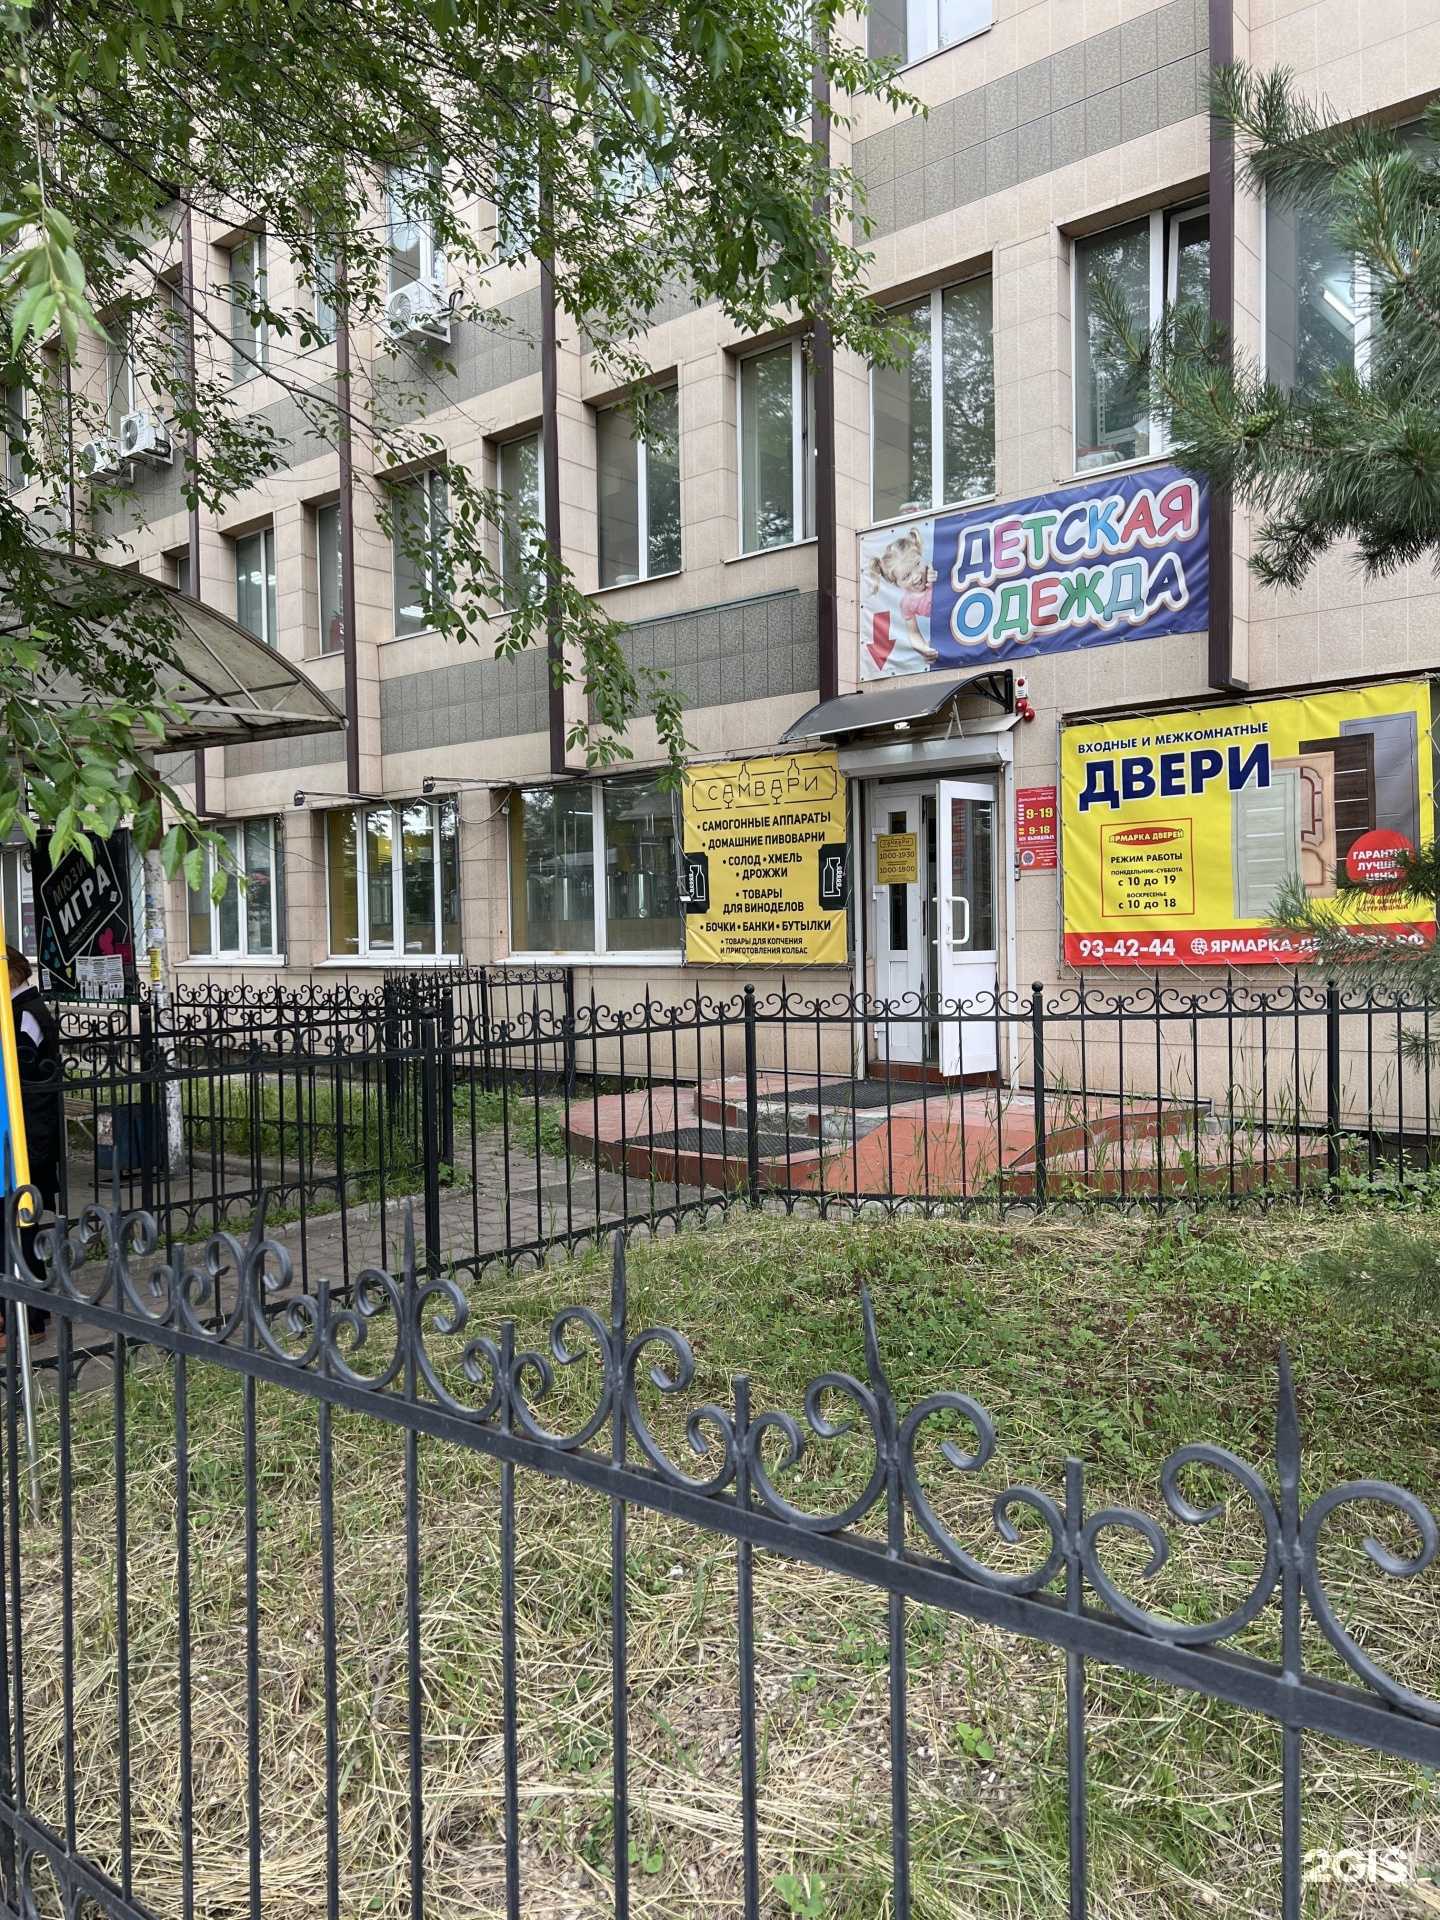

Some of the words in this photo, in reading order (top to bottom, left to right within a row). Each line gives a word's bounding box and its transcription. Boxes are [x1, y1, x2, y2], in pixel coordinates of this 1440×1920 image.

[956, 483, 1194, 584] ДЕТСКАЯ
[955, 557, 1184, 641] ОДЕЖДА
[1078, 738, 1137, 754] ВХОДНЫЕ
[1142, 737, 1150, 746] И
[1155, 722, 1268, 745] МЕЖКОМНАТНЫЕ
[1079, 742, 1271, 812] ДВЕРИ
[707, 775, 818, 807] САМВАРИ
[1026, 807, 1053, 819] 9-19
[702, 816, 770, 831] САМОГОННЫЕ
[772, 812, 830, 827] АППАРАТЫ
[708, 835, 763, 850] ДОМАШНИЕ
[765, 832, 825, 846] ПИВОВАРНИ
[728, 855, 761, 867] СОЛОД
[768, 853, 802, 865] ХМЕЛЬ
[1111, 855, 1143, 864] РЕЖИМ
[1146, 852, 1183, 862] РАБОТЫ
[1357, 861, 1404, 871] ЛУЧШЕ
[742, 868, 788, 881] ДРОЖЖИ
[1128, 877, 1140, 886] 10
[1143, 878, 1159, 887] до
[1163, 875, 1176, 884] 19
[58, 864, 111, 936] ИГРА
[742, 888, 782, 899] ТОВАРЫ
[723, 903, 743, 915] ДЛЯ
[744, 901, 804, 914] ВИНОДЕЛОВ
[1128, 899, 1140, 908] 10
[1144, 901, 1159, 909] до
[1163, 898, 1176, 908] 18
[705, 921, 736, 932] БОЧКИ
[742, 920, 775, 932] БАНКИ
[782, 920, 831, 932] БУТЫЛКИ
[751, 938, 766, 946] ДЛЯ
[766, 937, 803, 945] КОПЧЕНИЯ
[1079, 938, 1176, 957] 93-42-44
